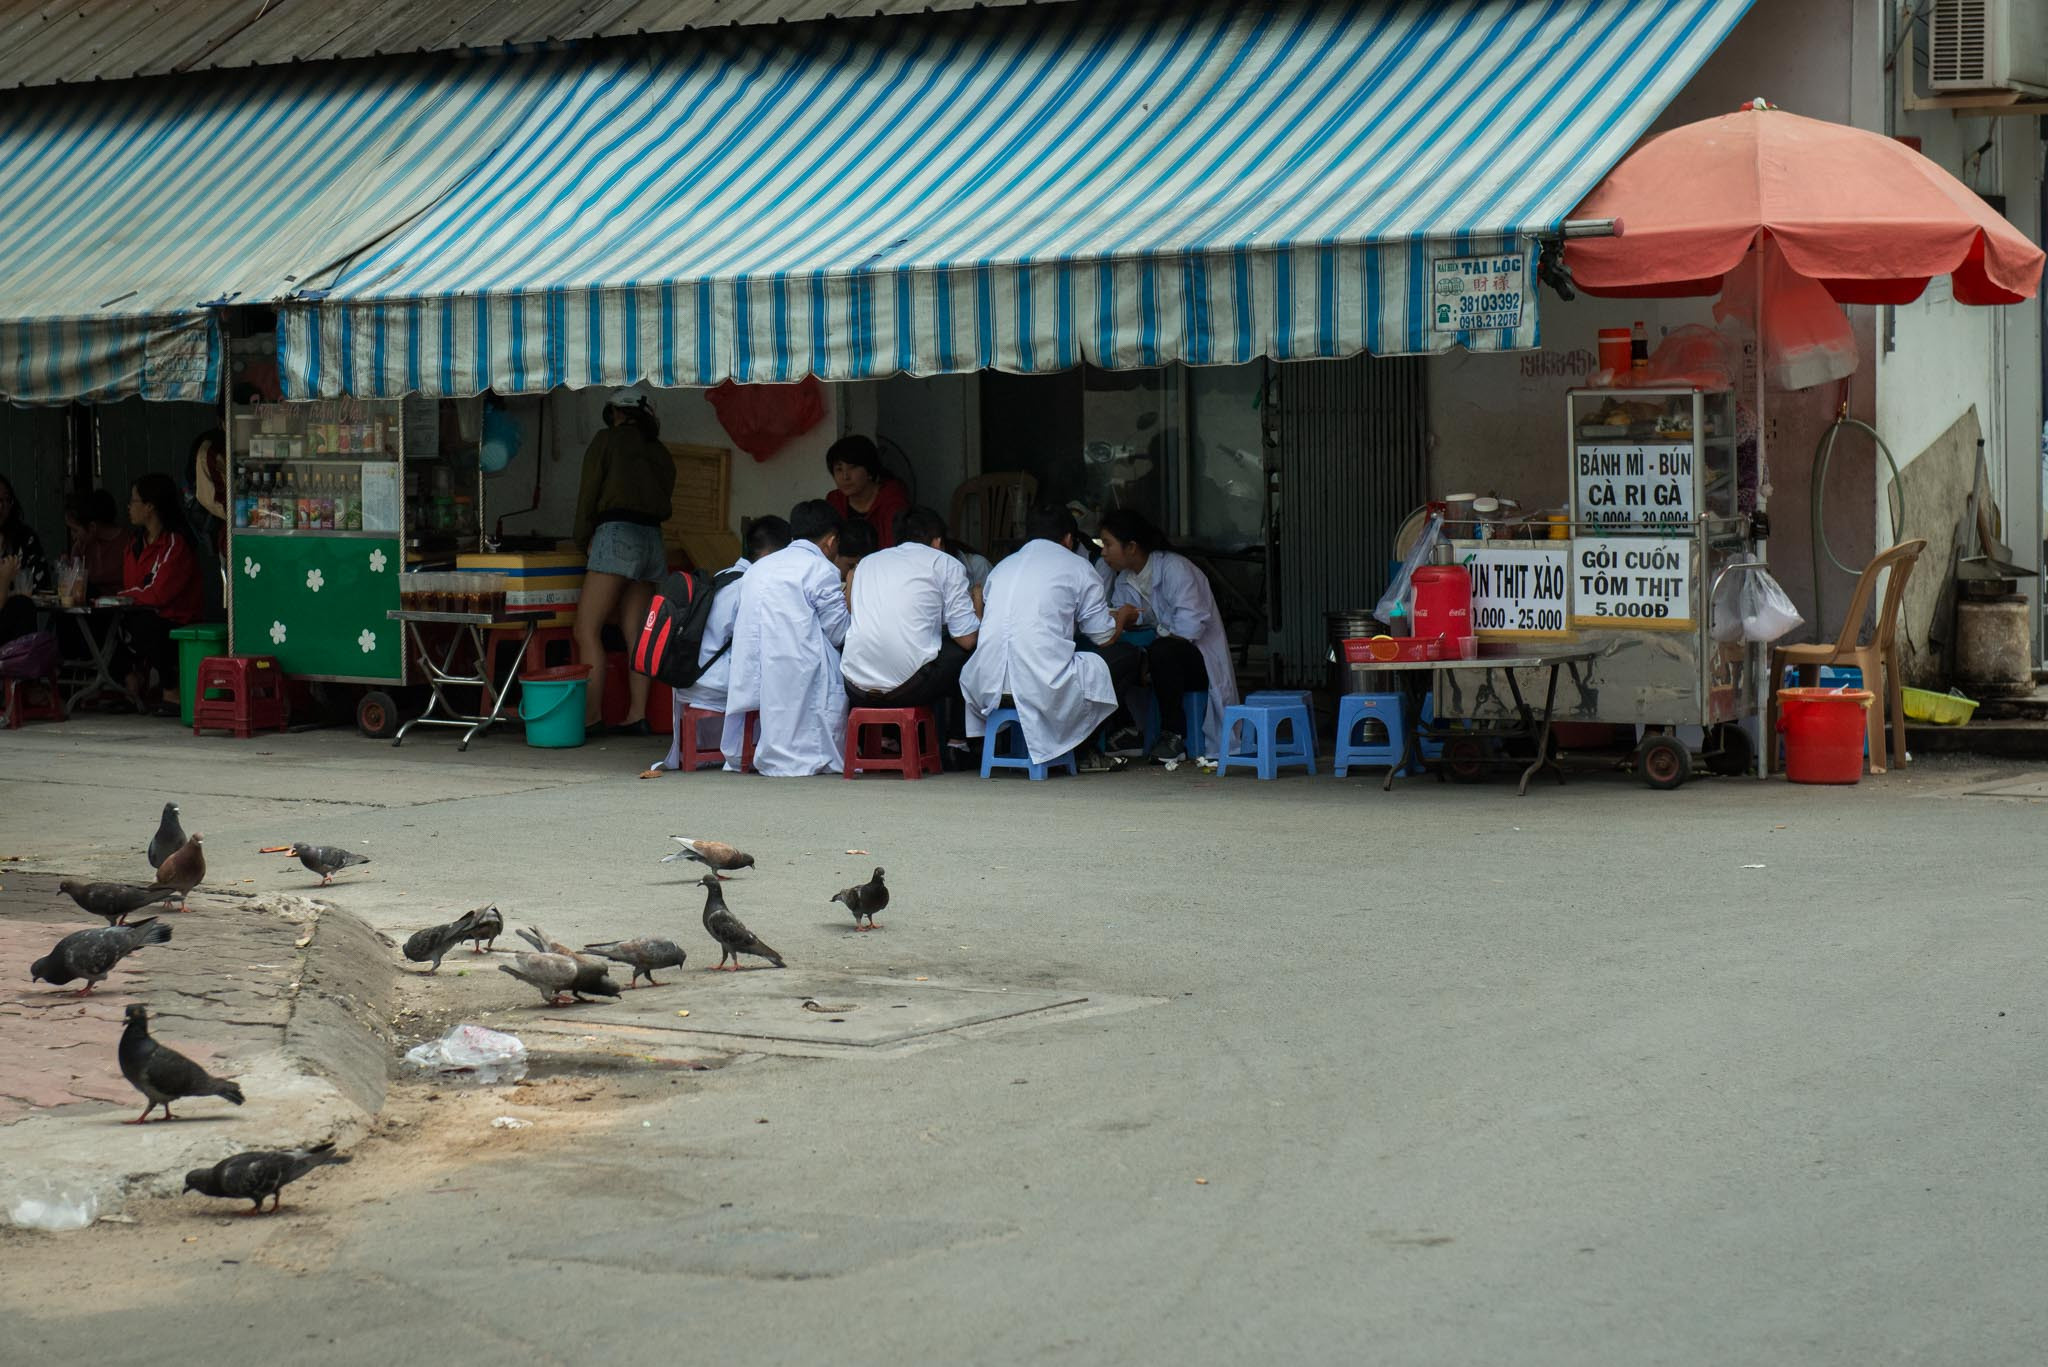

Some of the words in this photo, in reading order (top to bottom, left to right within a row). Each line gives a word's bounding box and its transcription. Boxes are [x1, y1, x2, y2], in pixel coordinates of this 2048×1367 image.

[1460, 293, 1520, 313] 38103392
[1460, 313, 1518, 329] 0918.212078
[1580, 448, 1620, 476] BÁNH
[1626, 448, 1644, 476] MÌ
[1659, 447, 1691, 476] BÚN
[1588, 478, 1617, 506] CÀ
[1625, 485, 1646, 506] RI
[1654, 478, 1682, 506] GÀ
[1582, 544, 1618, 569] GỎI
[1625, 545, 1680, 570] CUỐN
[1494, 564, 1529, 608] THỊT
[1533, 555, 1564, 601] XÀO
[1580, 571, 1628, 596] TÔM
[1635, 577, 1683, 602] THỊT
[1518, 608, 1562, 631] 25.000
[1595, 602, 1669, 618] 5.000Đ
